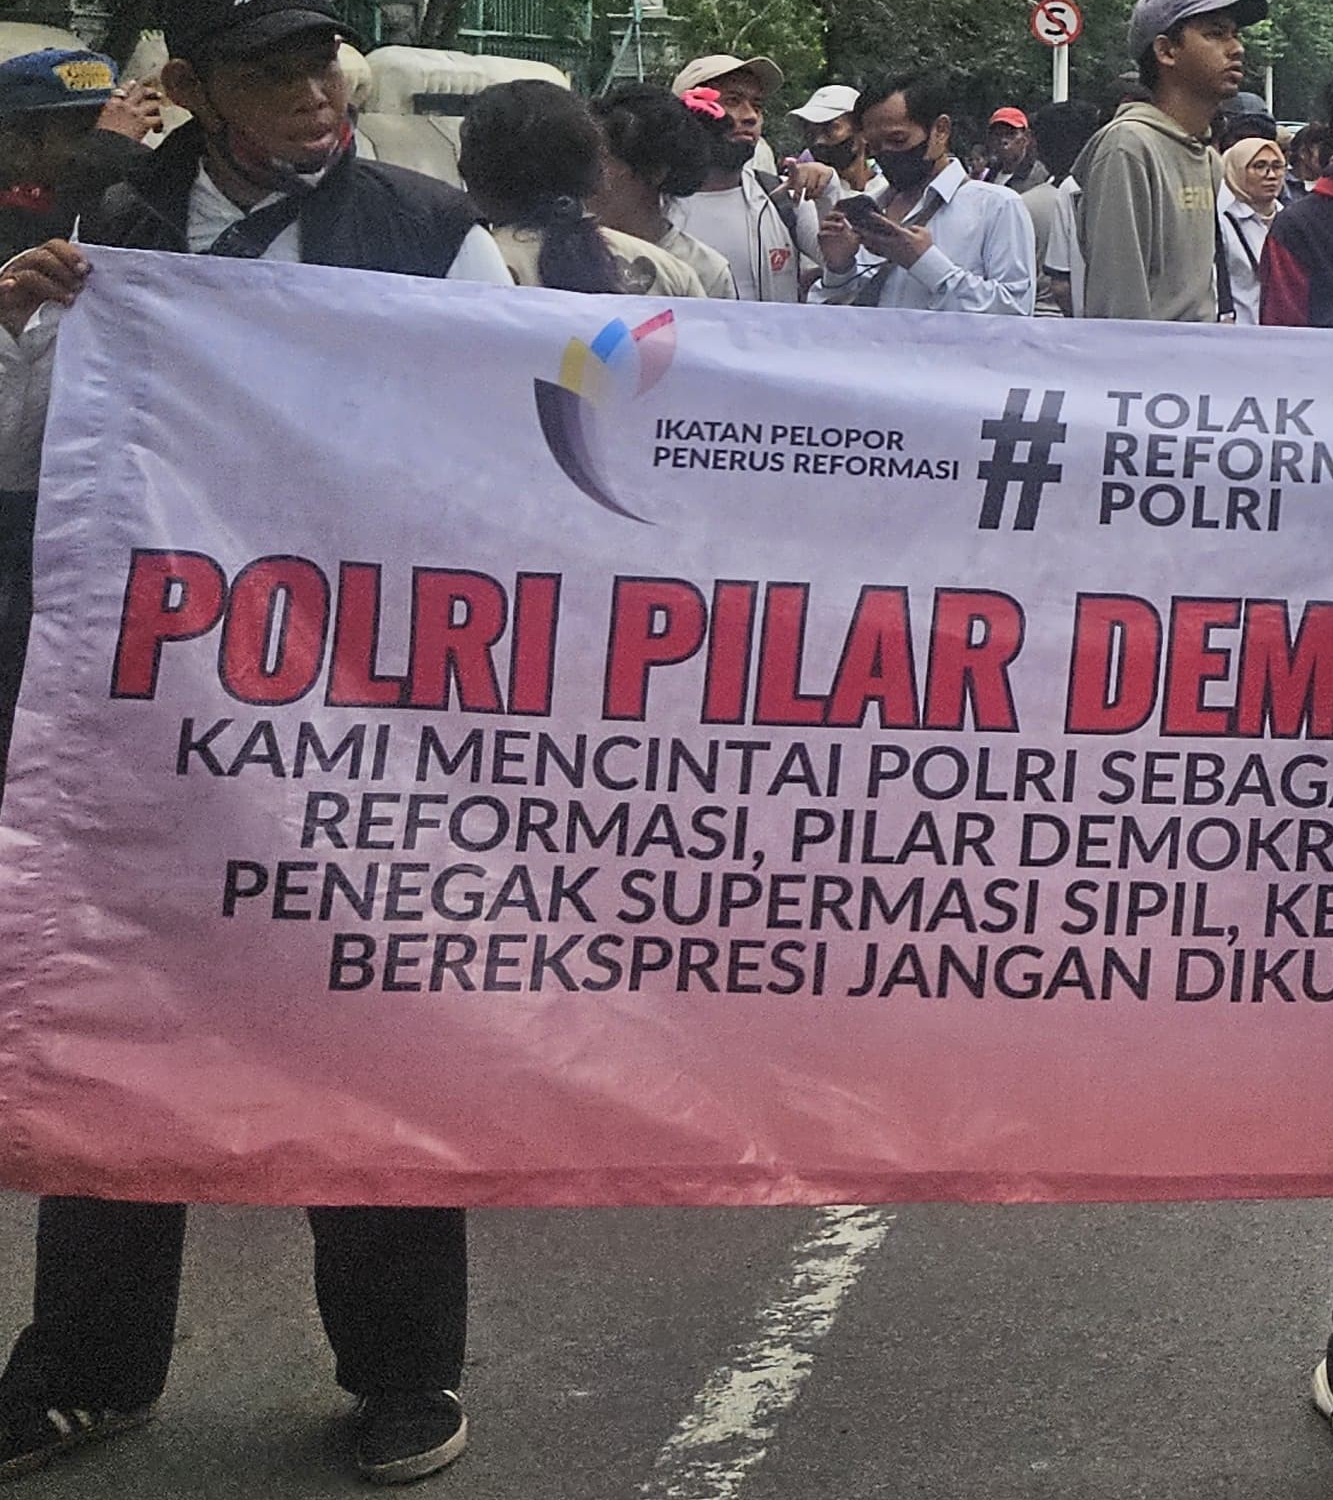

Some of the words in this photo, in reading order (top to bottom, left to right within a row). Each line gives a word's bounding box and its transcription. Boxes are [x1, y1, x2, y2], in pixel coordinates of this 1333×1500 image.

[655, 419, 763, 444] IKATAN
[771, 425, 905, 451] PELOPOR
[1105, 390, 1315, 437] TOLAK
[653, 446, 786, 472] PENERUS
[793, 453, 959, 480] REFORMASI
[978, 387, 1067, 531] #
[1099, 481, 1281, 533] POLRI
[111, 548, 562, 717] POLRI
[602, 575, 1025, 734] PILAR
[177, 717, 390, 781] KAMI
[416, 727, 842, 798] MENCINTAI
[867, 744, 1076, 803] POLRI
[300, 792, 765, 872] REFORMASI,
[791, 809, 996, 868] PILAR
[222, 860, 602, 925] PENEGAK
[617, 869, 1039, 935] SUPERMASI
[1060, 880, 1239, 947] SIPIL,
[328, 932, 827, 996] BEREKSPRESI
[848, 943, 1152, 1000] JANGAN
